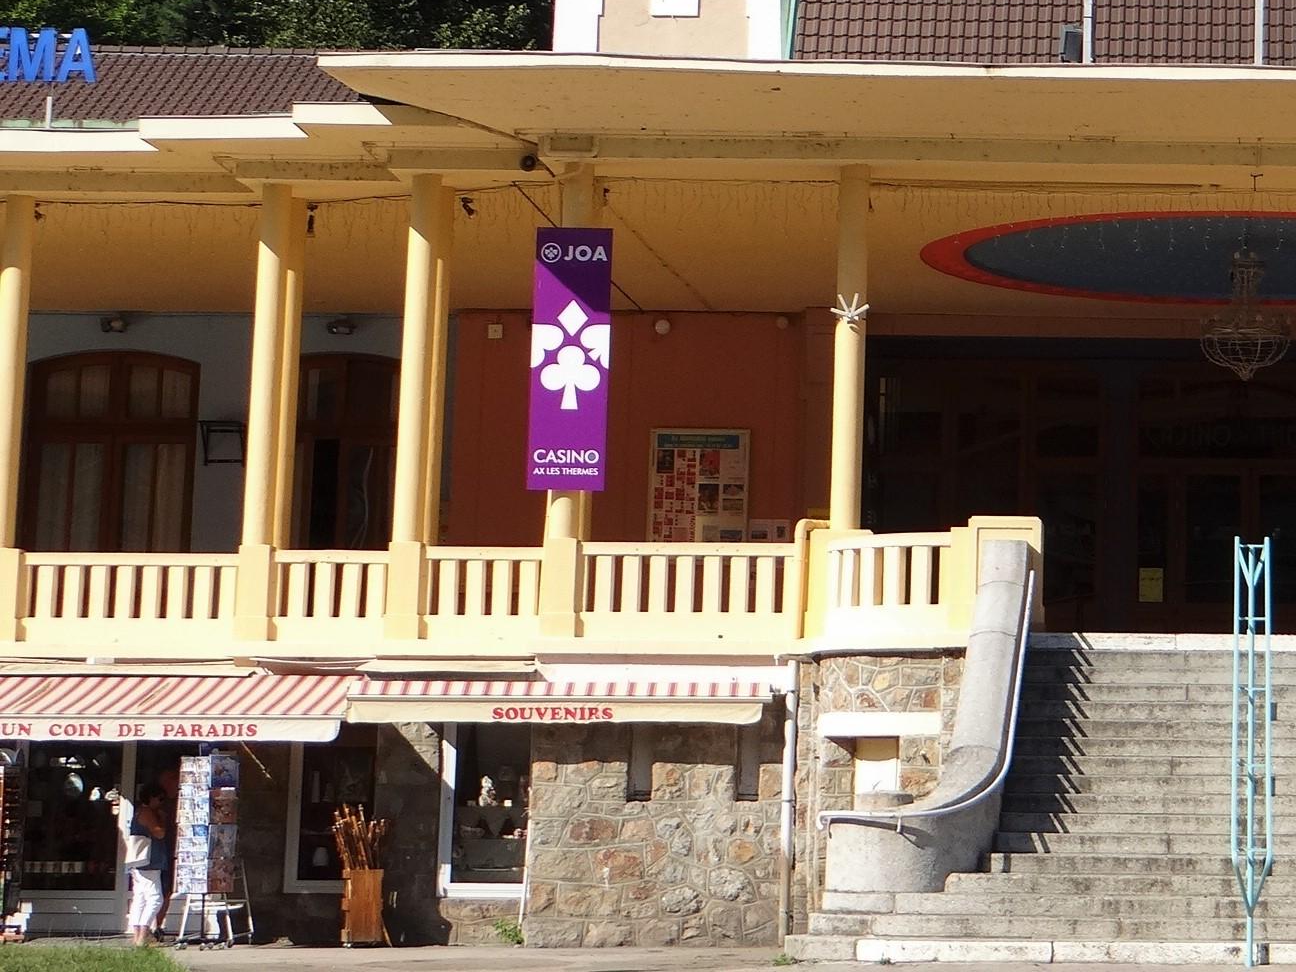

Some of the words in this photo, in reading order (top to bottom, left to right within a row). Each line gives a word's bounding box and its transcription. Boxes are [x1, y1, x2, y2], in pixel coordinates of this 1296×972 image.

[563, 245, 608, 262] JOA
[533, 449, 600, 464] CASINO
[533, 467, 545, 475] AX
[546, 467, 560, 475] LES
[561, 467, 599, 476] THERMES
[492, 707, 614, 721] SOUVENIRS
[1, 723, 32, 737] UN
[48, 723, 103, 737] COIN
[117, 724, 146, 737] DE
[162, 723, 259, 737] PARADIS
